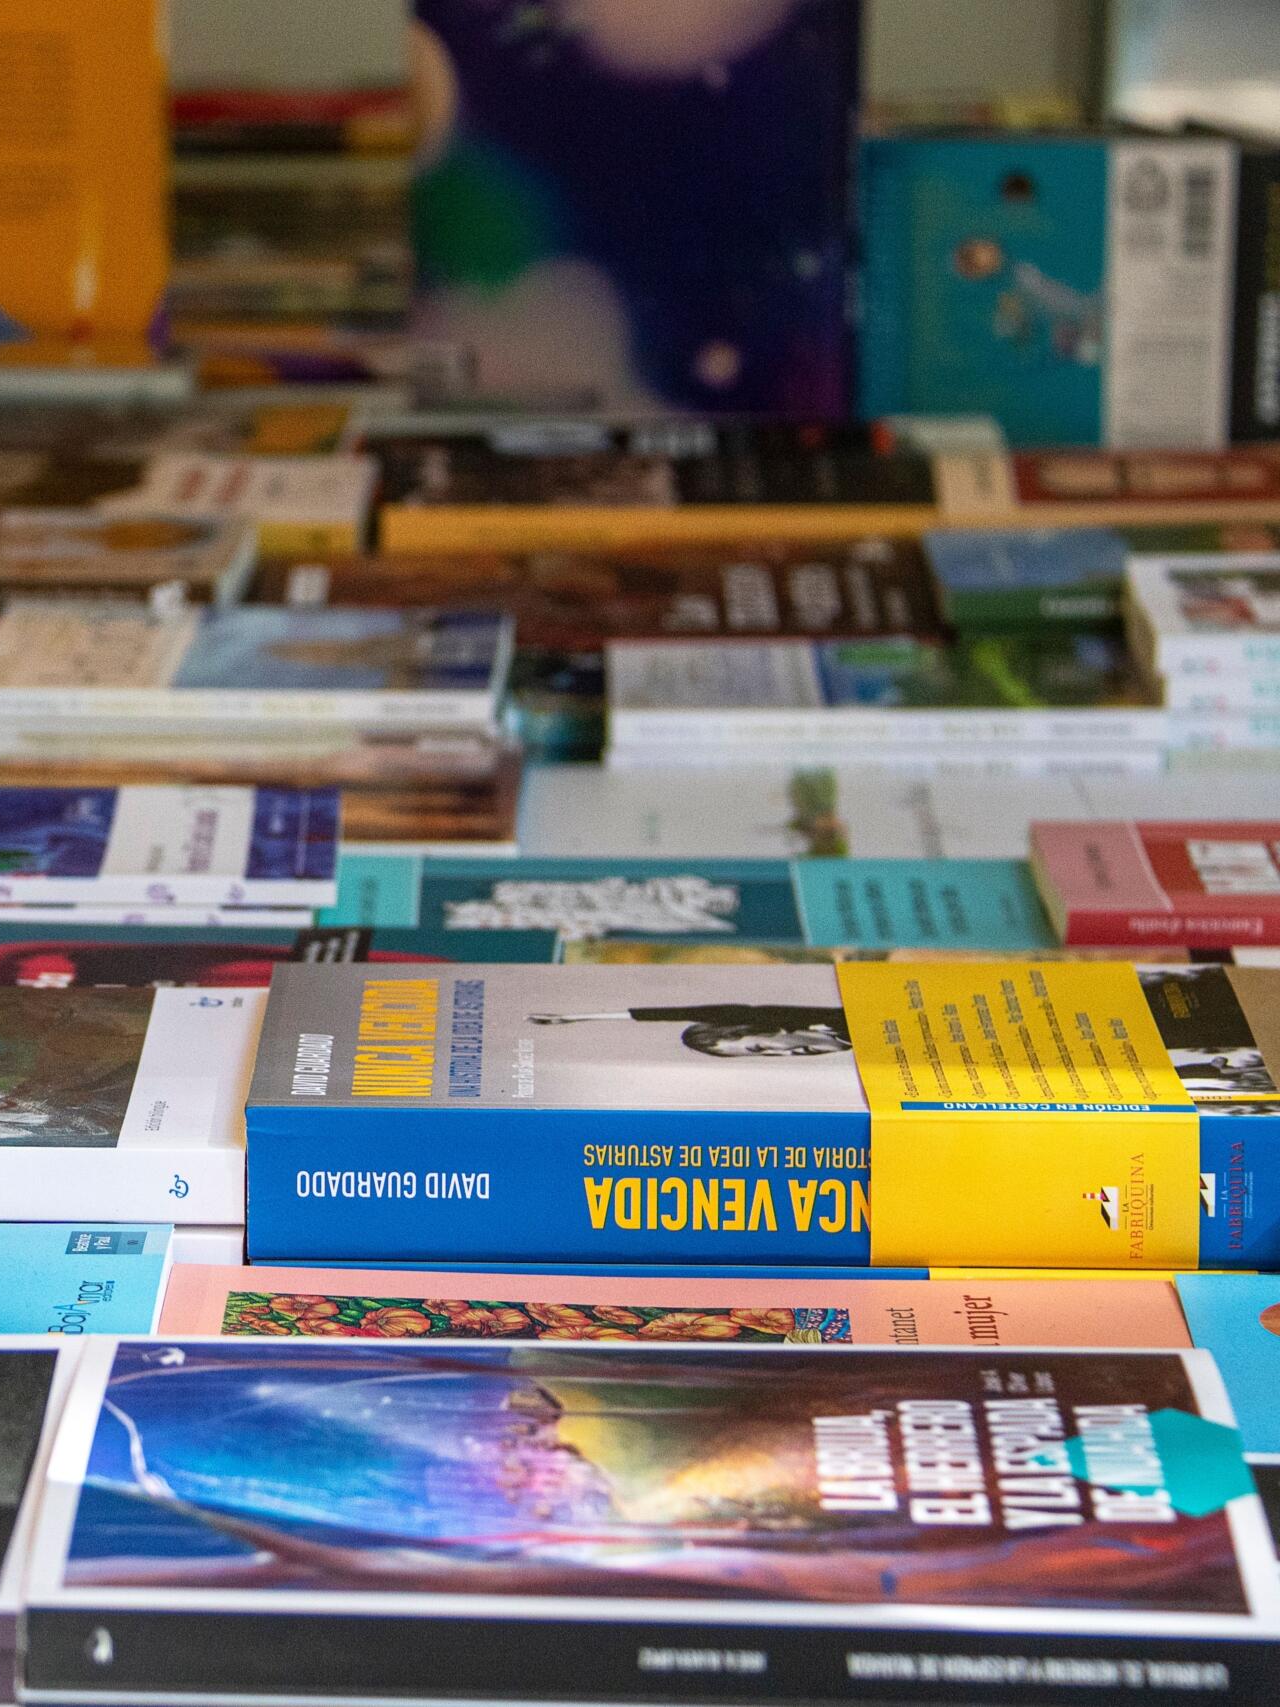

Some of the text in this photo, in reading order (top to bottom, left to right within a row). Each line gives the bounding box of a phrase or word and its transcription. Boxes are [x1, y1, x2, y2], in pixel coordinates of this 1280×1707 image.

[351, 979, 440, 1097] NUNCA VENCIDA
[291, 1033, 335, 1095] DAVID GUARDADO
[944, 1102, 1051, 1110] CASTELLANO
[1083, 1104, 1151, 1113] EDICIÓN
[583, 1144, 673, 1167] ASTURIAS
[679, 1145, 702, 1167] DE
[708, 1145, 750, 1168] IDEA
[757, 1146, 778, 1168] LA
[784, 1146, 806, 1168] DE
[296, 1170, 490, 1200] DAVID GUARDADO
[1228, 1141, 1247, 1250] FABRIQUINA
[583, 1176, 777, 1232] VENCIDA
[1130, 1153, 1147, 1260] FABRIQUINA
[953, 1295, 1009, 1340] mujer
[984, 1397, 1074, 1477] ESPADA
[896, 1399, 992, 1525] EL HERRERO
[820, 1478, 899, 1512] LA
[998, 1476, 1080, 1510] LA
[1003, 1510, 1085, 1530] Y
